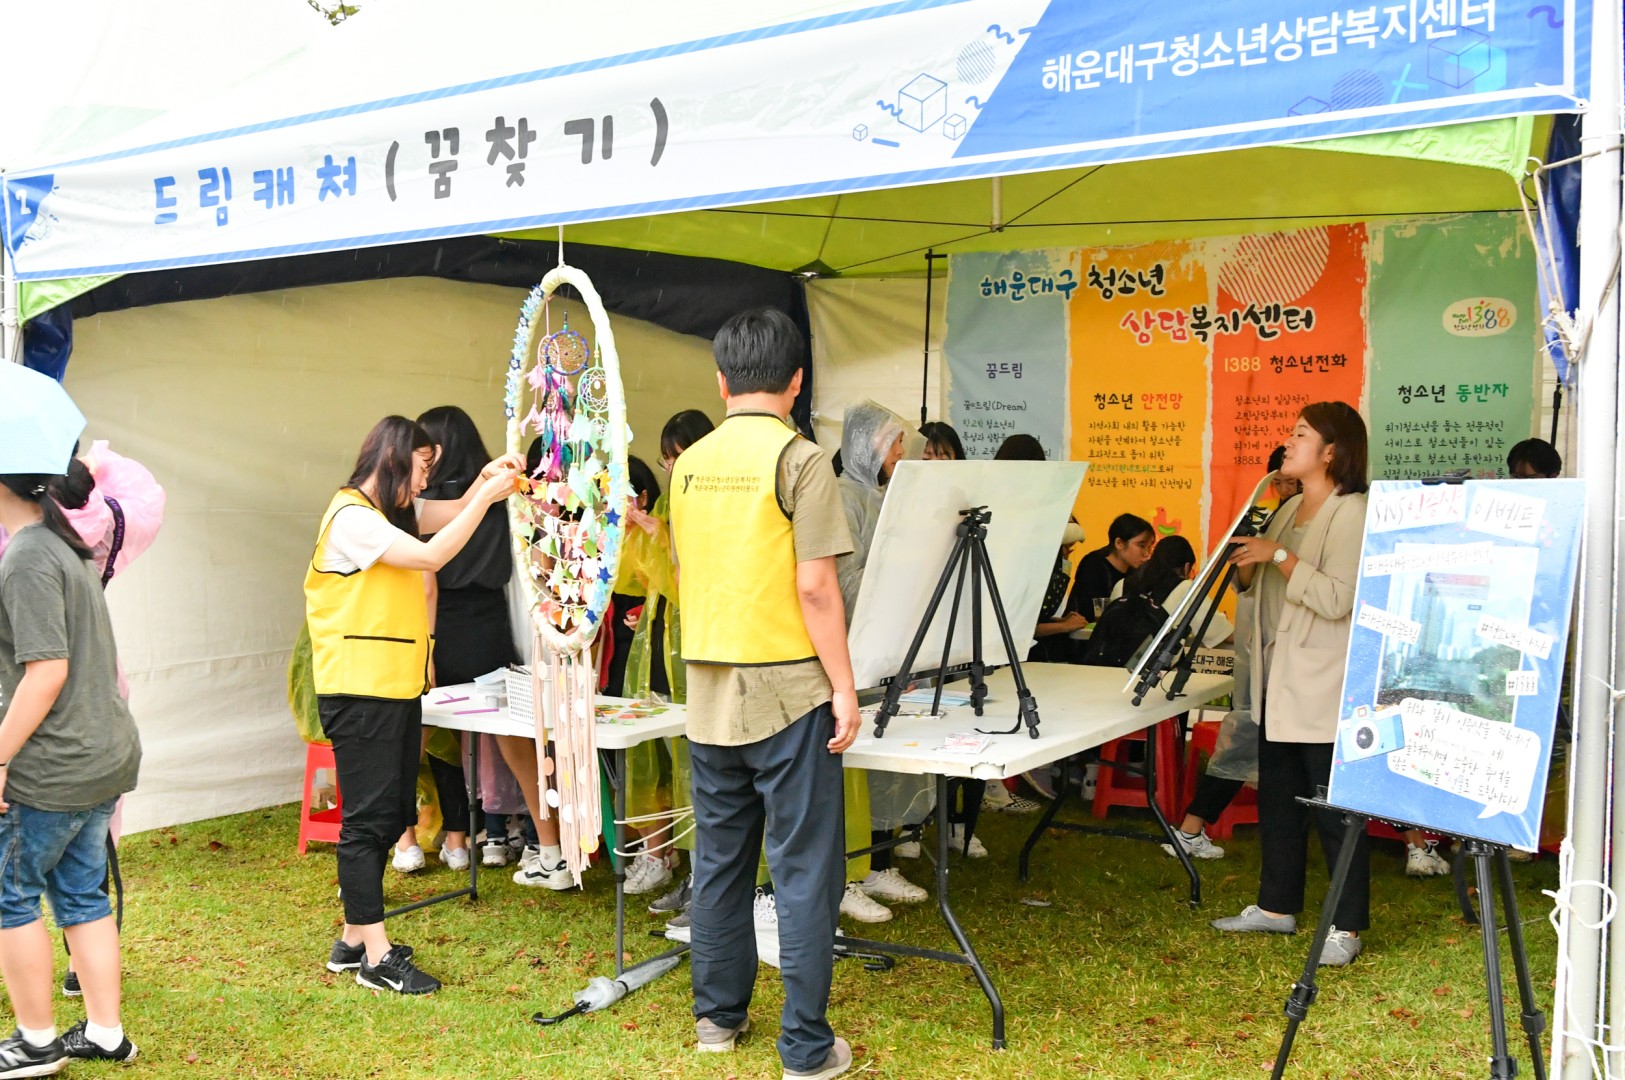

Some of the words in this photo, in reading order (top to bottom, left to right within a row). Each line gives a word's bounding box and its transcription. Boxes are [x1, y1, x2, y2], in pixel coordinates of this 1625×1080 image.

[1041, 0, 1497, 93] 해운대구청소년상담복지센터
[980, 269, 1077, 300] 해운대구
[1088, 263, 1165, 300] 청소년
[1121, 302, 1314, 344] 상담복지센터
[1467, 305, 1510, 329] 1388
[986, 362, 1023, 379] 꿈드림
[1224, 356, 1261, 372] 1388
[1269, 353, 1348, 374] 청소년전화
[1093, 392, 1133, 410] 청소년
[1141, 393, 1184, 410] 안전망
[1235, 395, 1270, 406] 청소년의
[1398, 384, 1446, 404] 청소년
[1456, 383, 1509, 403] 동반자
[986, 419, 1015, 430] 청소년의
[1089, 421, 1120, 430] 지역사회
[1123, 421, 1139, 430] 내의
[1161, 420, 1186, 432] 가능한
[1466, 420, 1504, 432] 전문적인
[1088, 435, 1111, 446] 자원을
[1150, 435, 1182, 446] 청소년을
[1385, 438, 1422, 448] 서비스로
[1428, 436, 1478, 449] 청소년들이
[1485, 437, 1505, 449] 있는
[1088, 449, 1126, 459] 효과적으로
[1149, 450, 1165, 460] 위한
[1233, 456, 1262, 465] 1388로
[1384, 453, 1422, 465] 현장으로
[1428, 452, 1457, 465] 청소년
[1462, 453, 1503, 465] 동반자가
[1088, 477, 1118, 488] 청소년을
[1122, 478, 1137, 488] 위한
[1140, 478, 1157, 488] 사회
[1474, 498, 1533, 529] 이벤트
[1419, 725, 1437, 742] SNS
